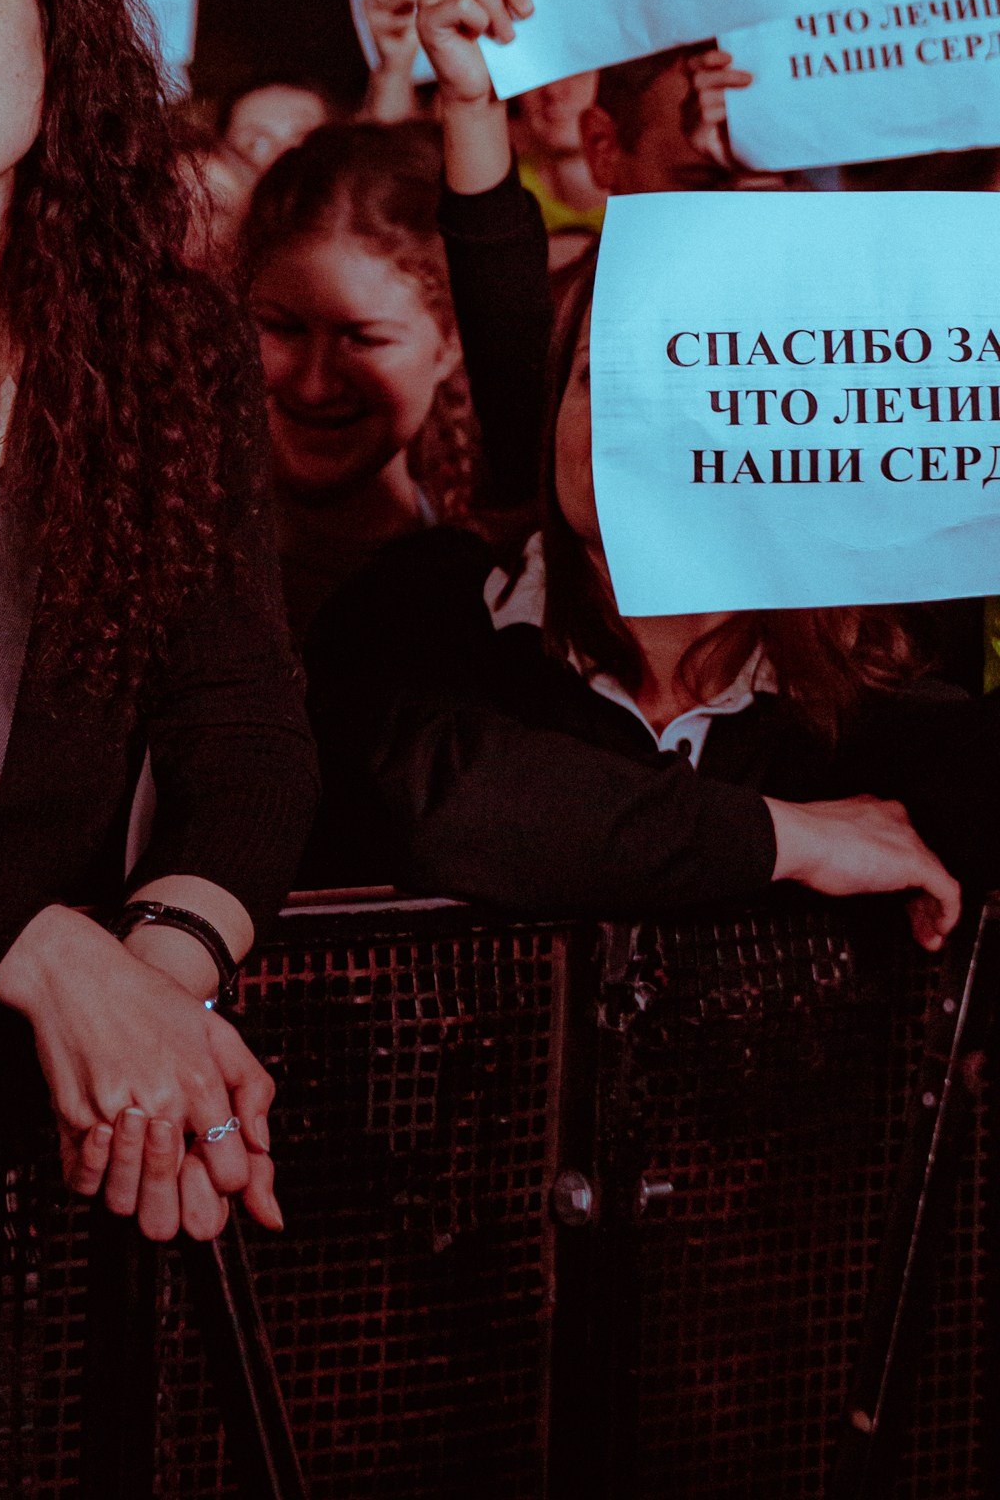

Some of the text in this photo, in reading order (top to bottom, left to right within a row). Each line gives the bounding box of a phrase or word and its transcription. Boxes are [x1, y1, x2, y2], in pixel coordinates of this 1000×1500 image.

[795, 8, 870, 37] ЧТО
[789, 43, 904, 80] НАШИ
[665, 327, 1000, 367] СПАСИБО ЗА
[706, 386, 1000, 426] ЧТО ЛЕЧИ
[689, 448, 864, 484] НАШИ
